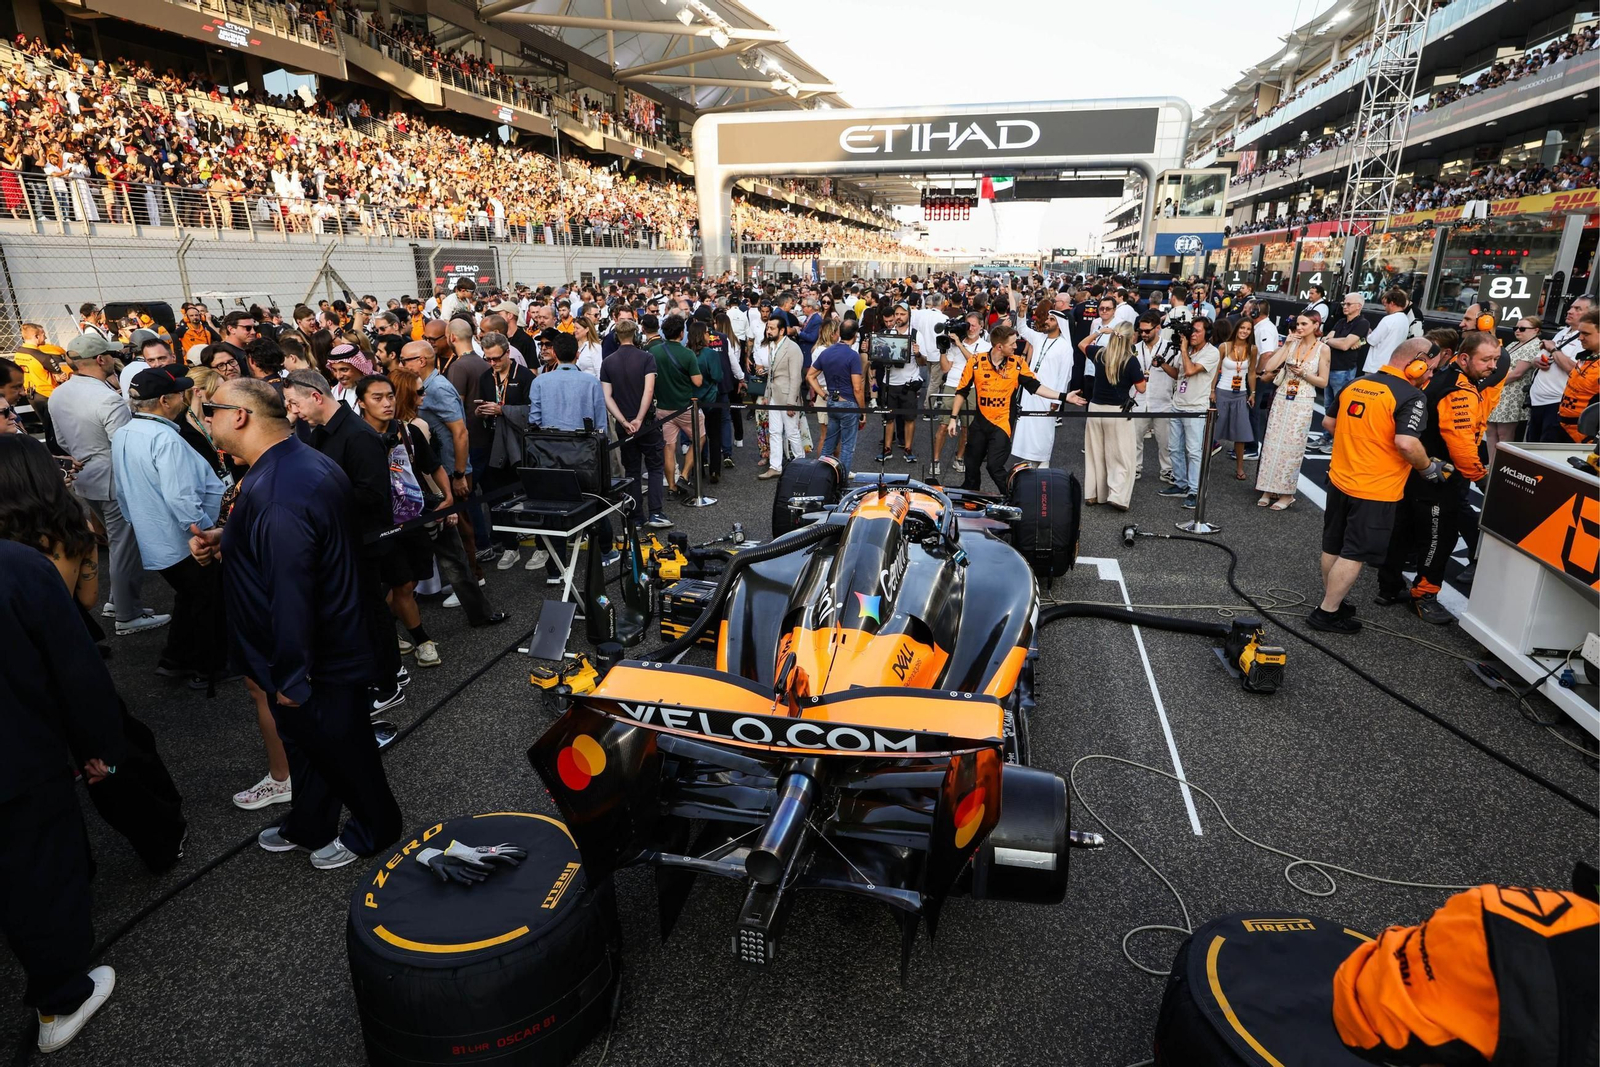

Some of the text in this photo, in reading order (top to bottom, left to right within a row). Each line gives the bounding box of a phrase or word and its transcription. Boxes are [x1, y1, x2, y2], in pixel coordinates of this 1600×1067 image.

[1518, 72, 1564, 92] PADDOCK CLUB
[838, 119, 1041, 154] ETIHAD
[1491, 201, 1520, 217] DHL
[1552, 191, 1599, 212] DHL
[1393, 215, 1416, 227] DHL
[1434, 209, 1462, 222] DHL
[1176, 240, 1202, 250] FIA
[1232, 271, 1241, 282] 1
[1309, 272, 1323, 285] 4
[1489, 276, 1532, 299] 81
[1501, 306, 1523, 321] IA
[1351, 387, 1379, 397] McLaren
[979, 397, 1006, 407] OKX
[1500, 465, 1537, 487] McLaren
[380, 527, 402, 537] McLaren
[1424, 540, 1438, 567] NUTRITION
[892, 643, 915, 682] DELL
[617, 702, 918, 753] VELO.COM
[364, 822, 444, 909] P ZERO
[540, 862, 582, 909] PIRELLI
[1241, 918, 1317, 933] PIRELLI
[452, 1014, 557, 1055] 81 LHR OSCAR 81
